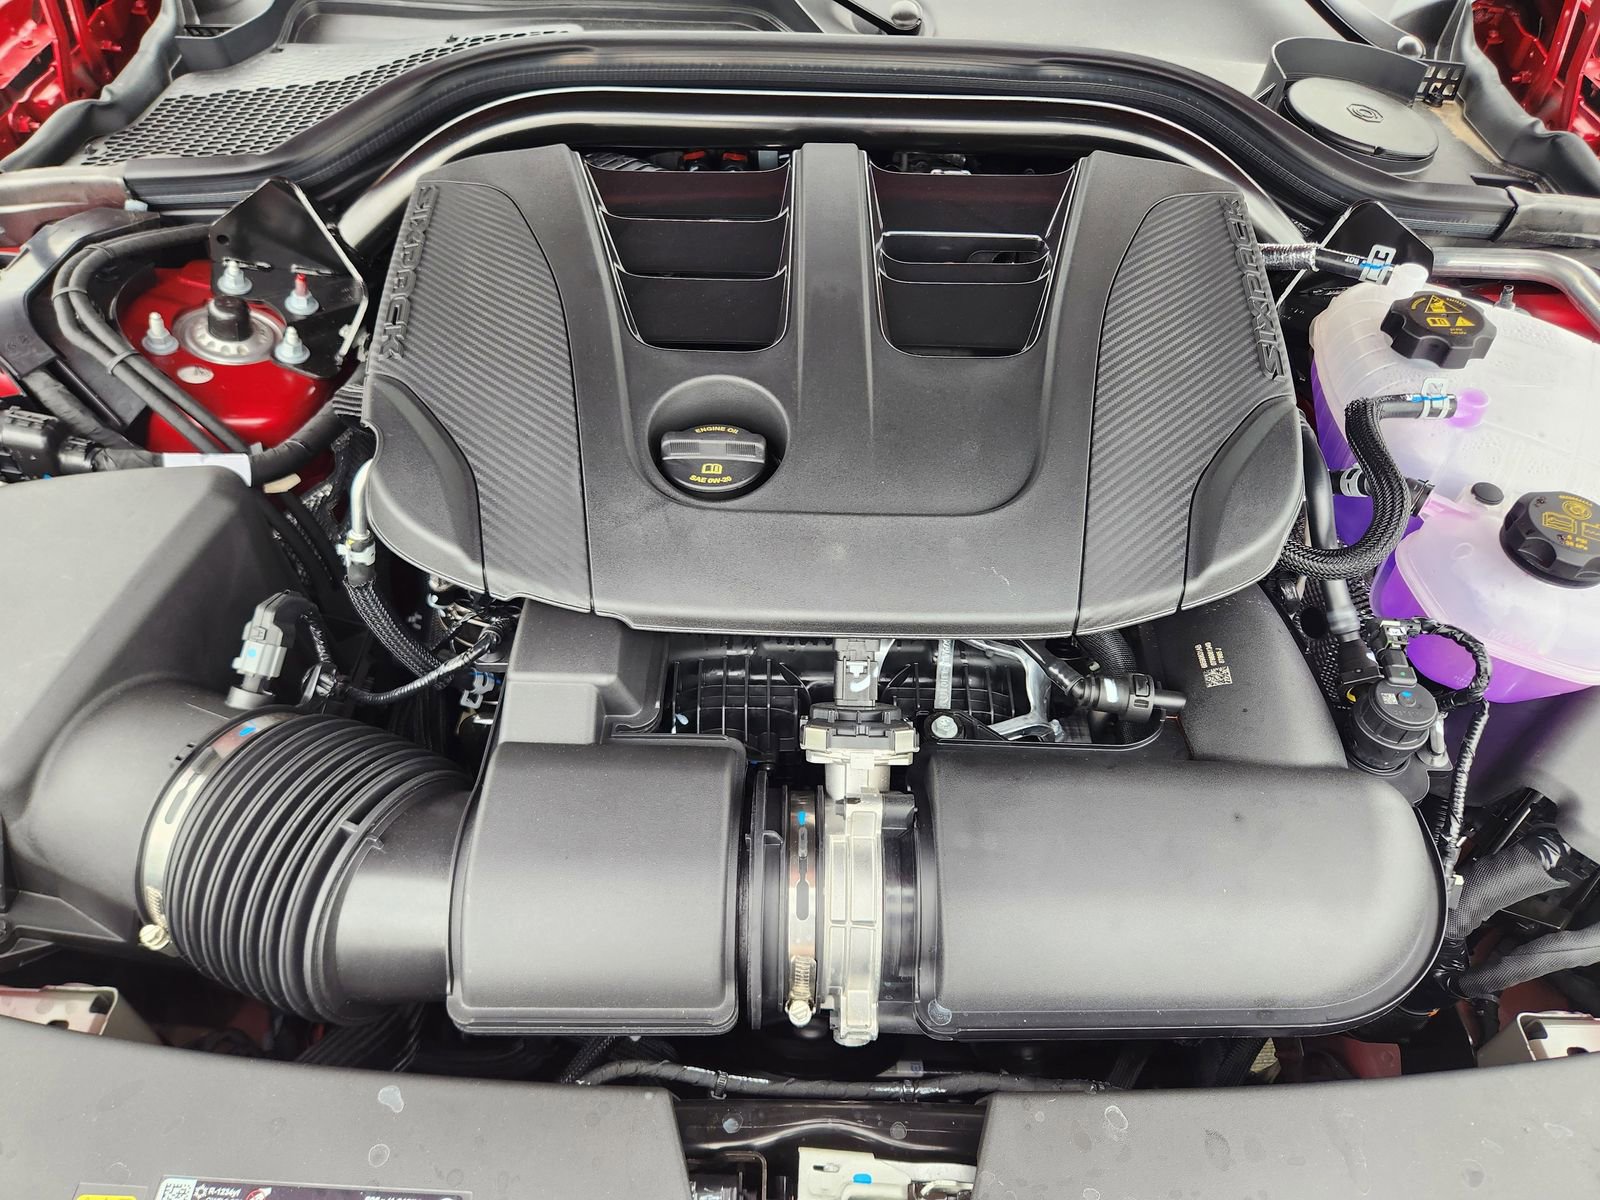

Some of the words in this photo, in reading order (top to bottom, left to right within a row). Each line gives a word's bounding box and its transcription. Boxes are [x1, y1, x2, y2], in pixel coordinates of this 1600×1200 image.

[694, 426, 726, 434] ENGINE
[727, 426, 739, 434] OIL
[689, 474, 706, 483] SAE
